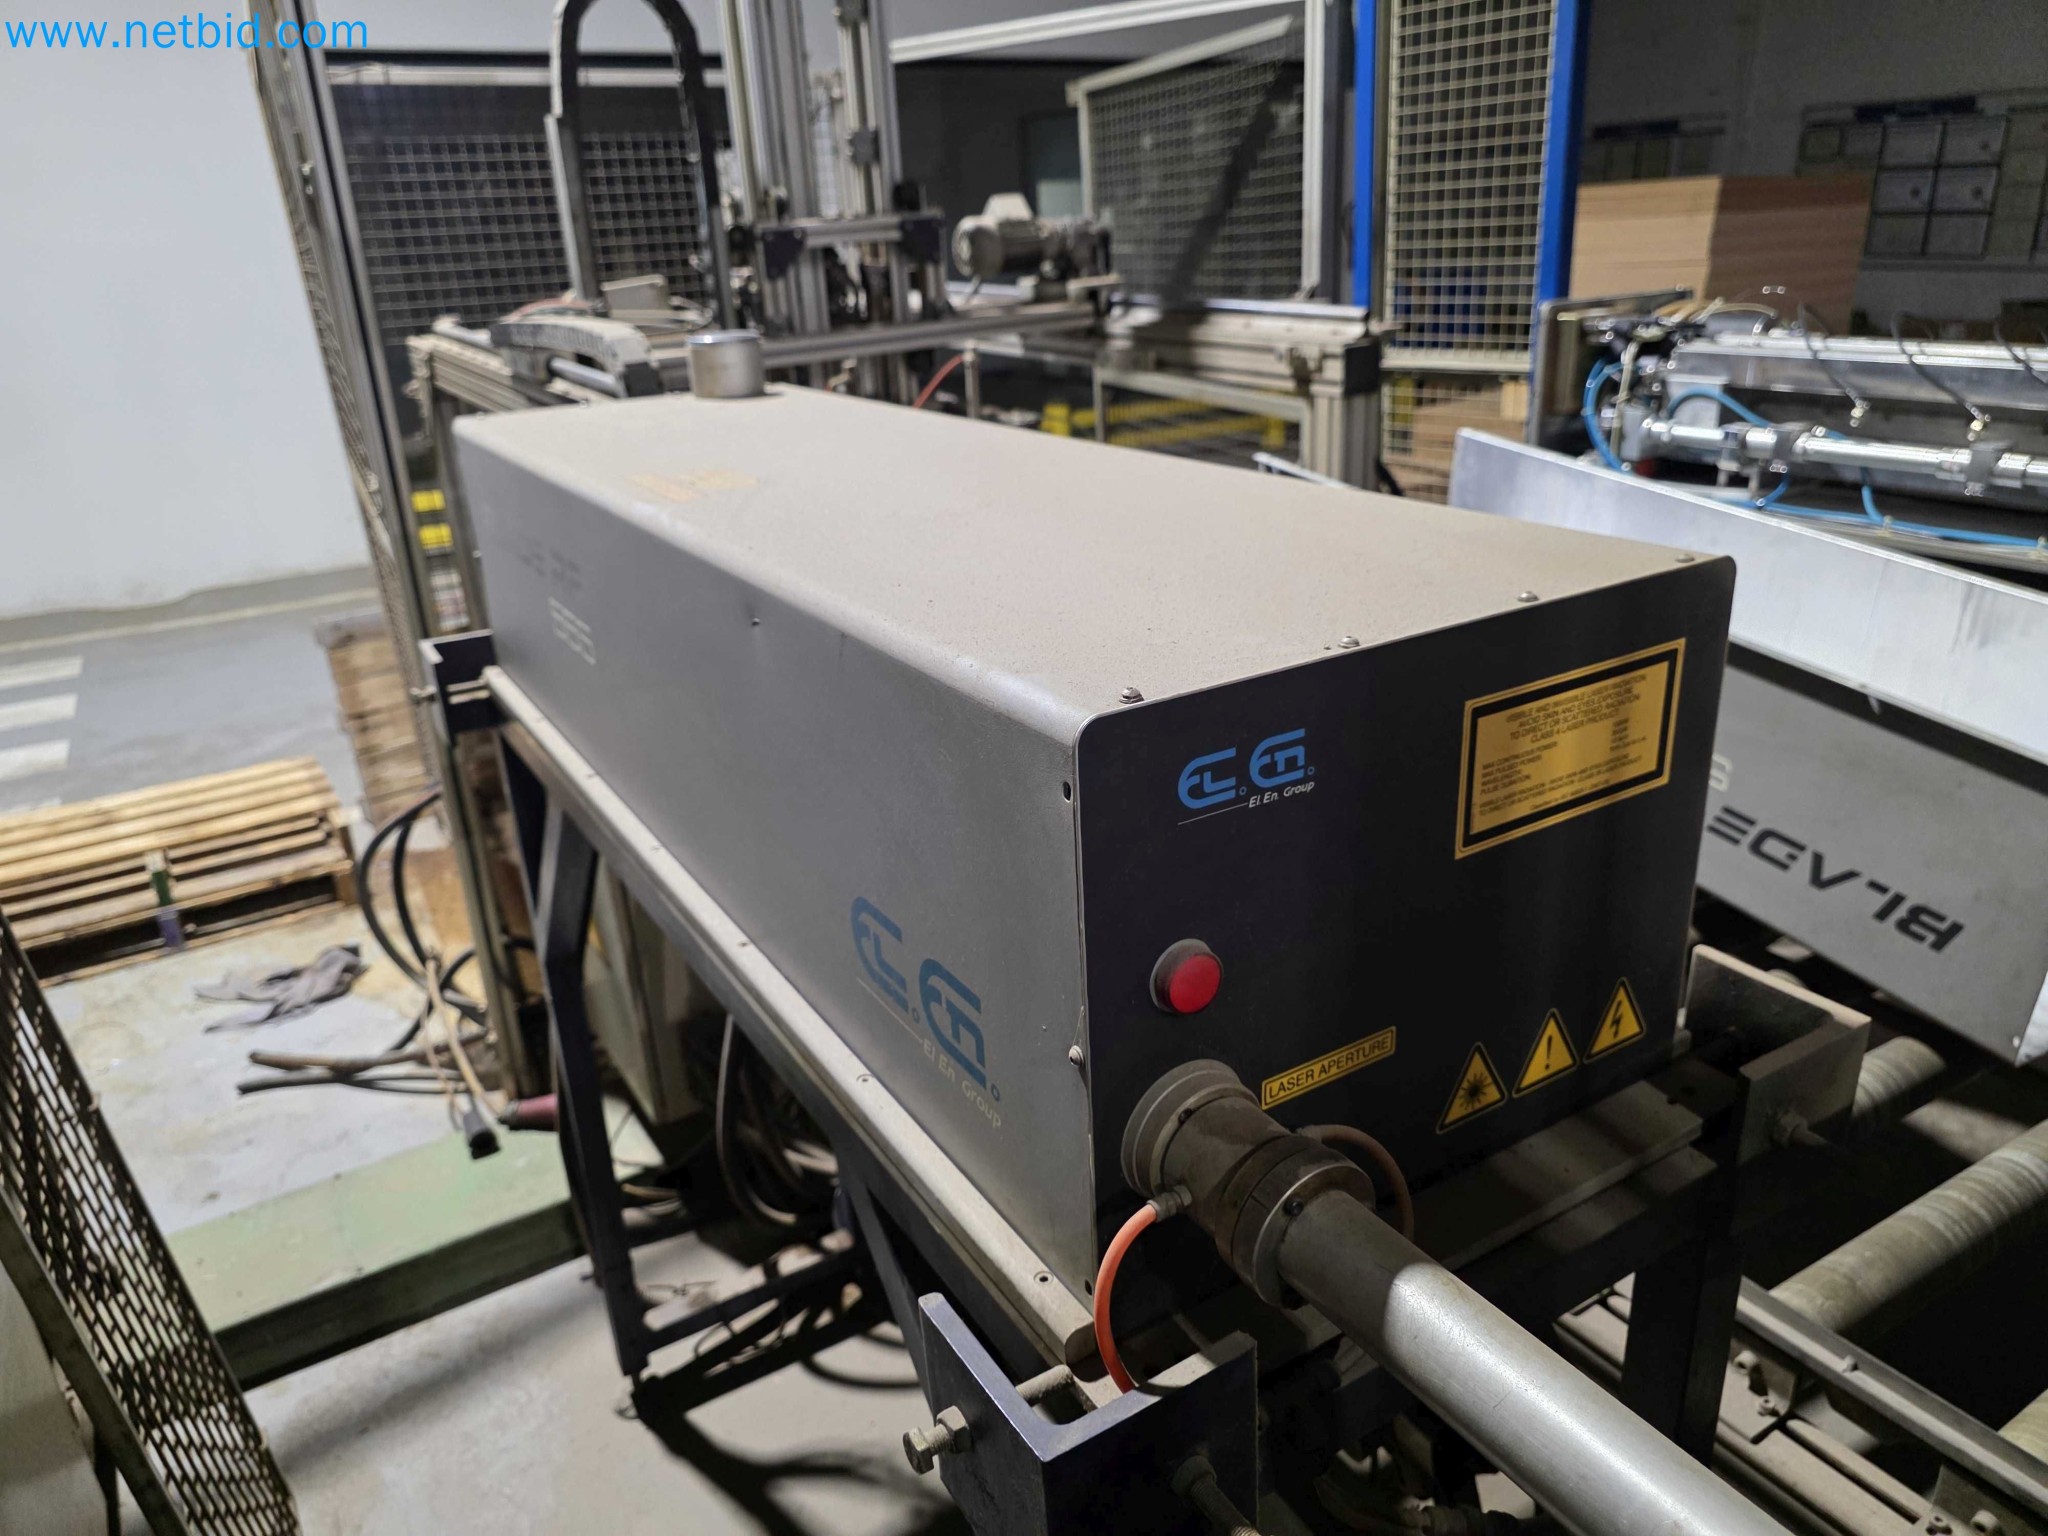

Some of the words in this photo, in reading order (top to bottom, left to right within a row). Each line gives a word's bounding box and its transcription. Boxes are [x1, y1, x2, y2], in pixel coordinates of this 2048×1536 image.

[1283, 781, 1315, 797] Group
[1706, 804, 1965, 954] BLADE
[1269, 1068, 1315, 1099] LASER
[1317, 1036, 1390, 1078] APERTURE
[962, 1080, 1001, 1128] Group
